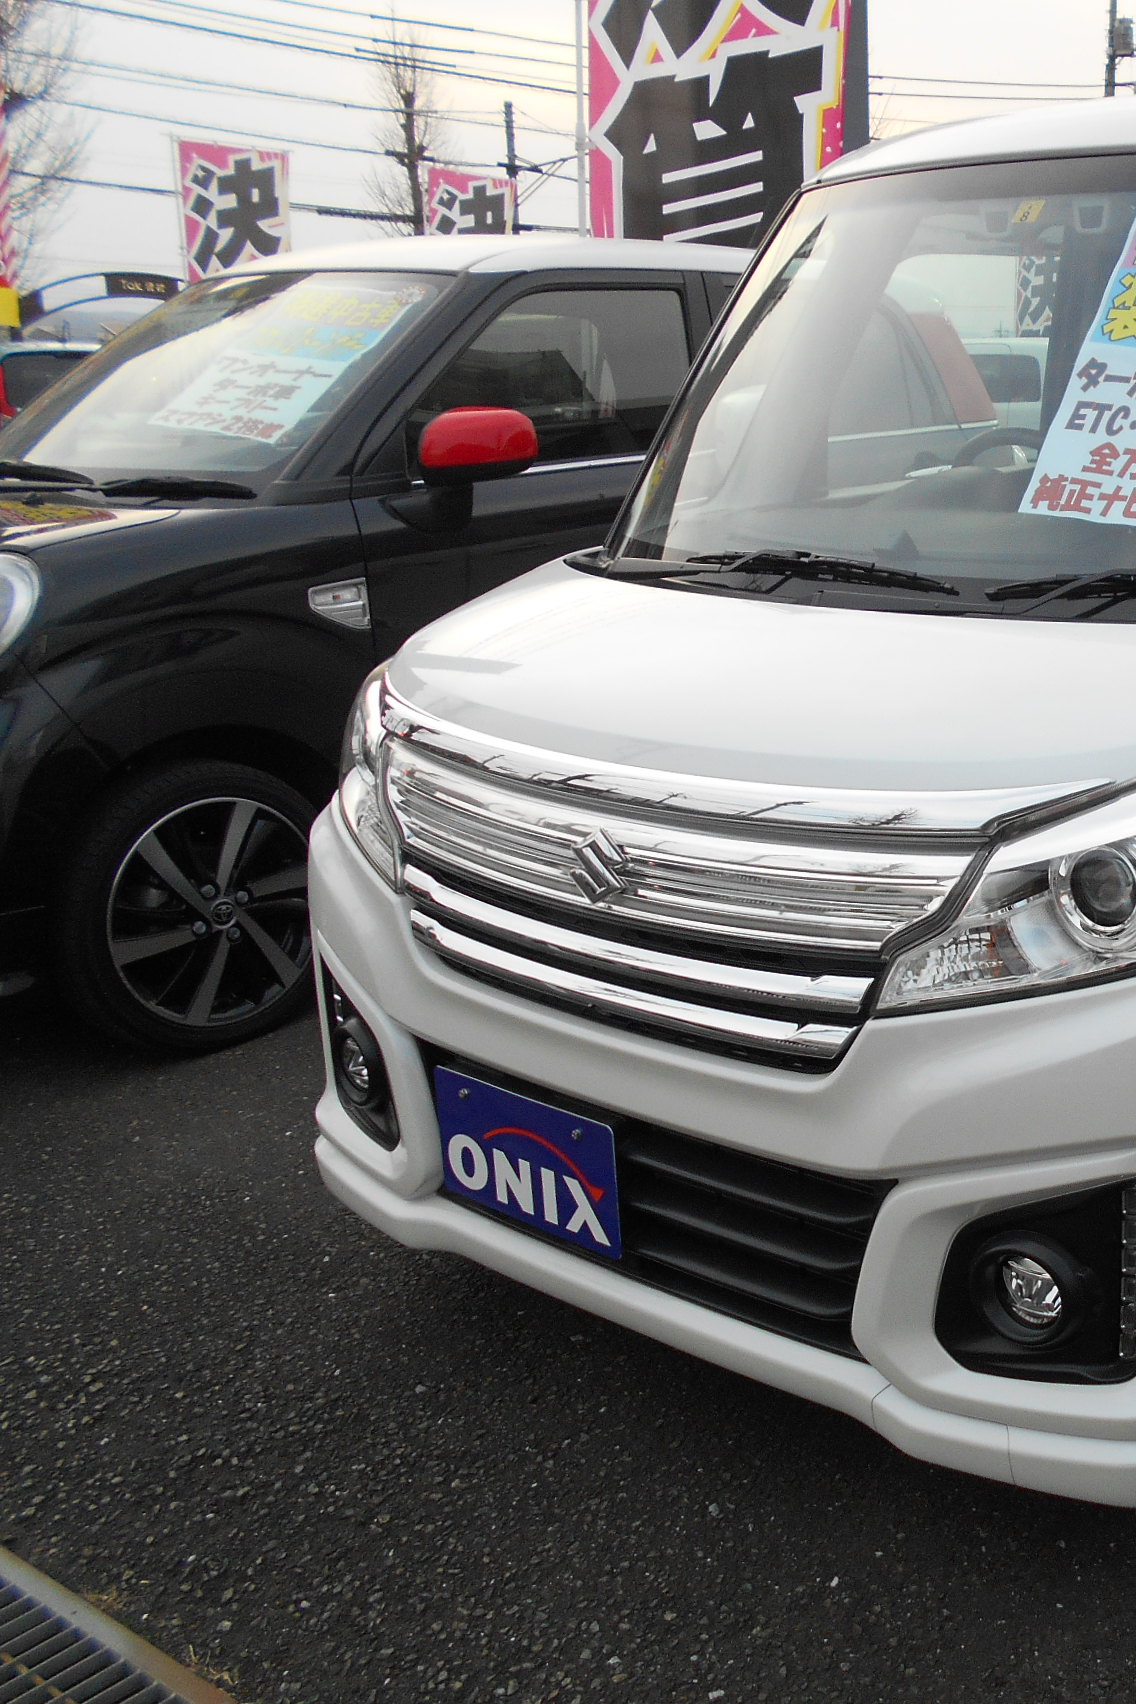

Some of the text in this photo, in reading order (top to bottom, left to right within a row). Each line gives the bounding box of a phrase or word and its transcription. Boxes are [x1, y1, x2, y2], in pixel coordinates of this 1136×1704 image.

[189, 156, 280, 273] 決
[213, 377, 302, 400] ターボ車
[218, 355, 333, 381] ワンオーナー
[447, 1133, 612, 1248] ONIX
